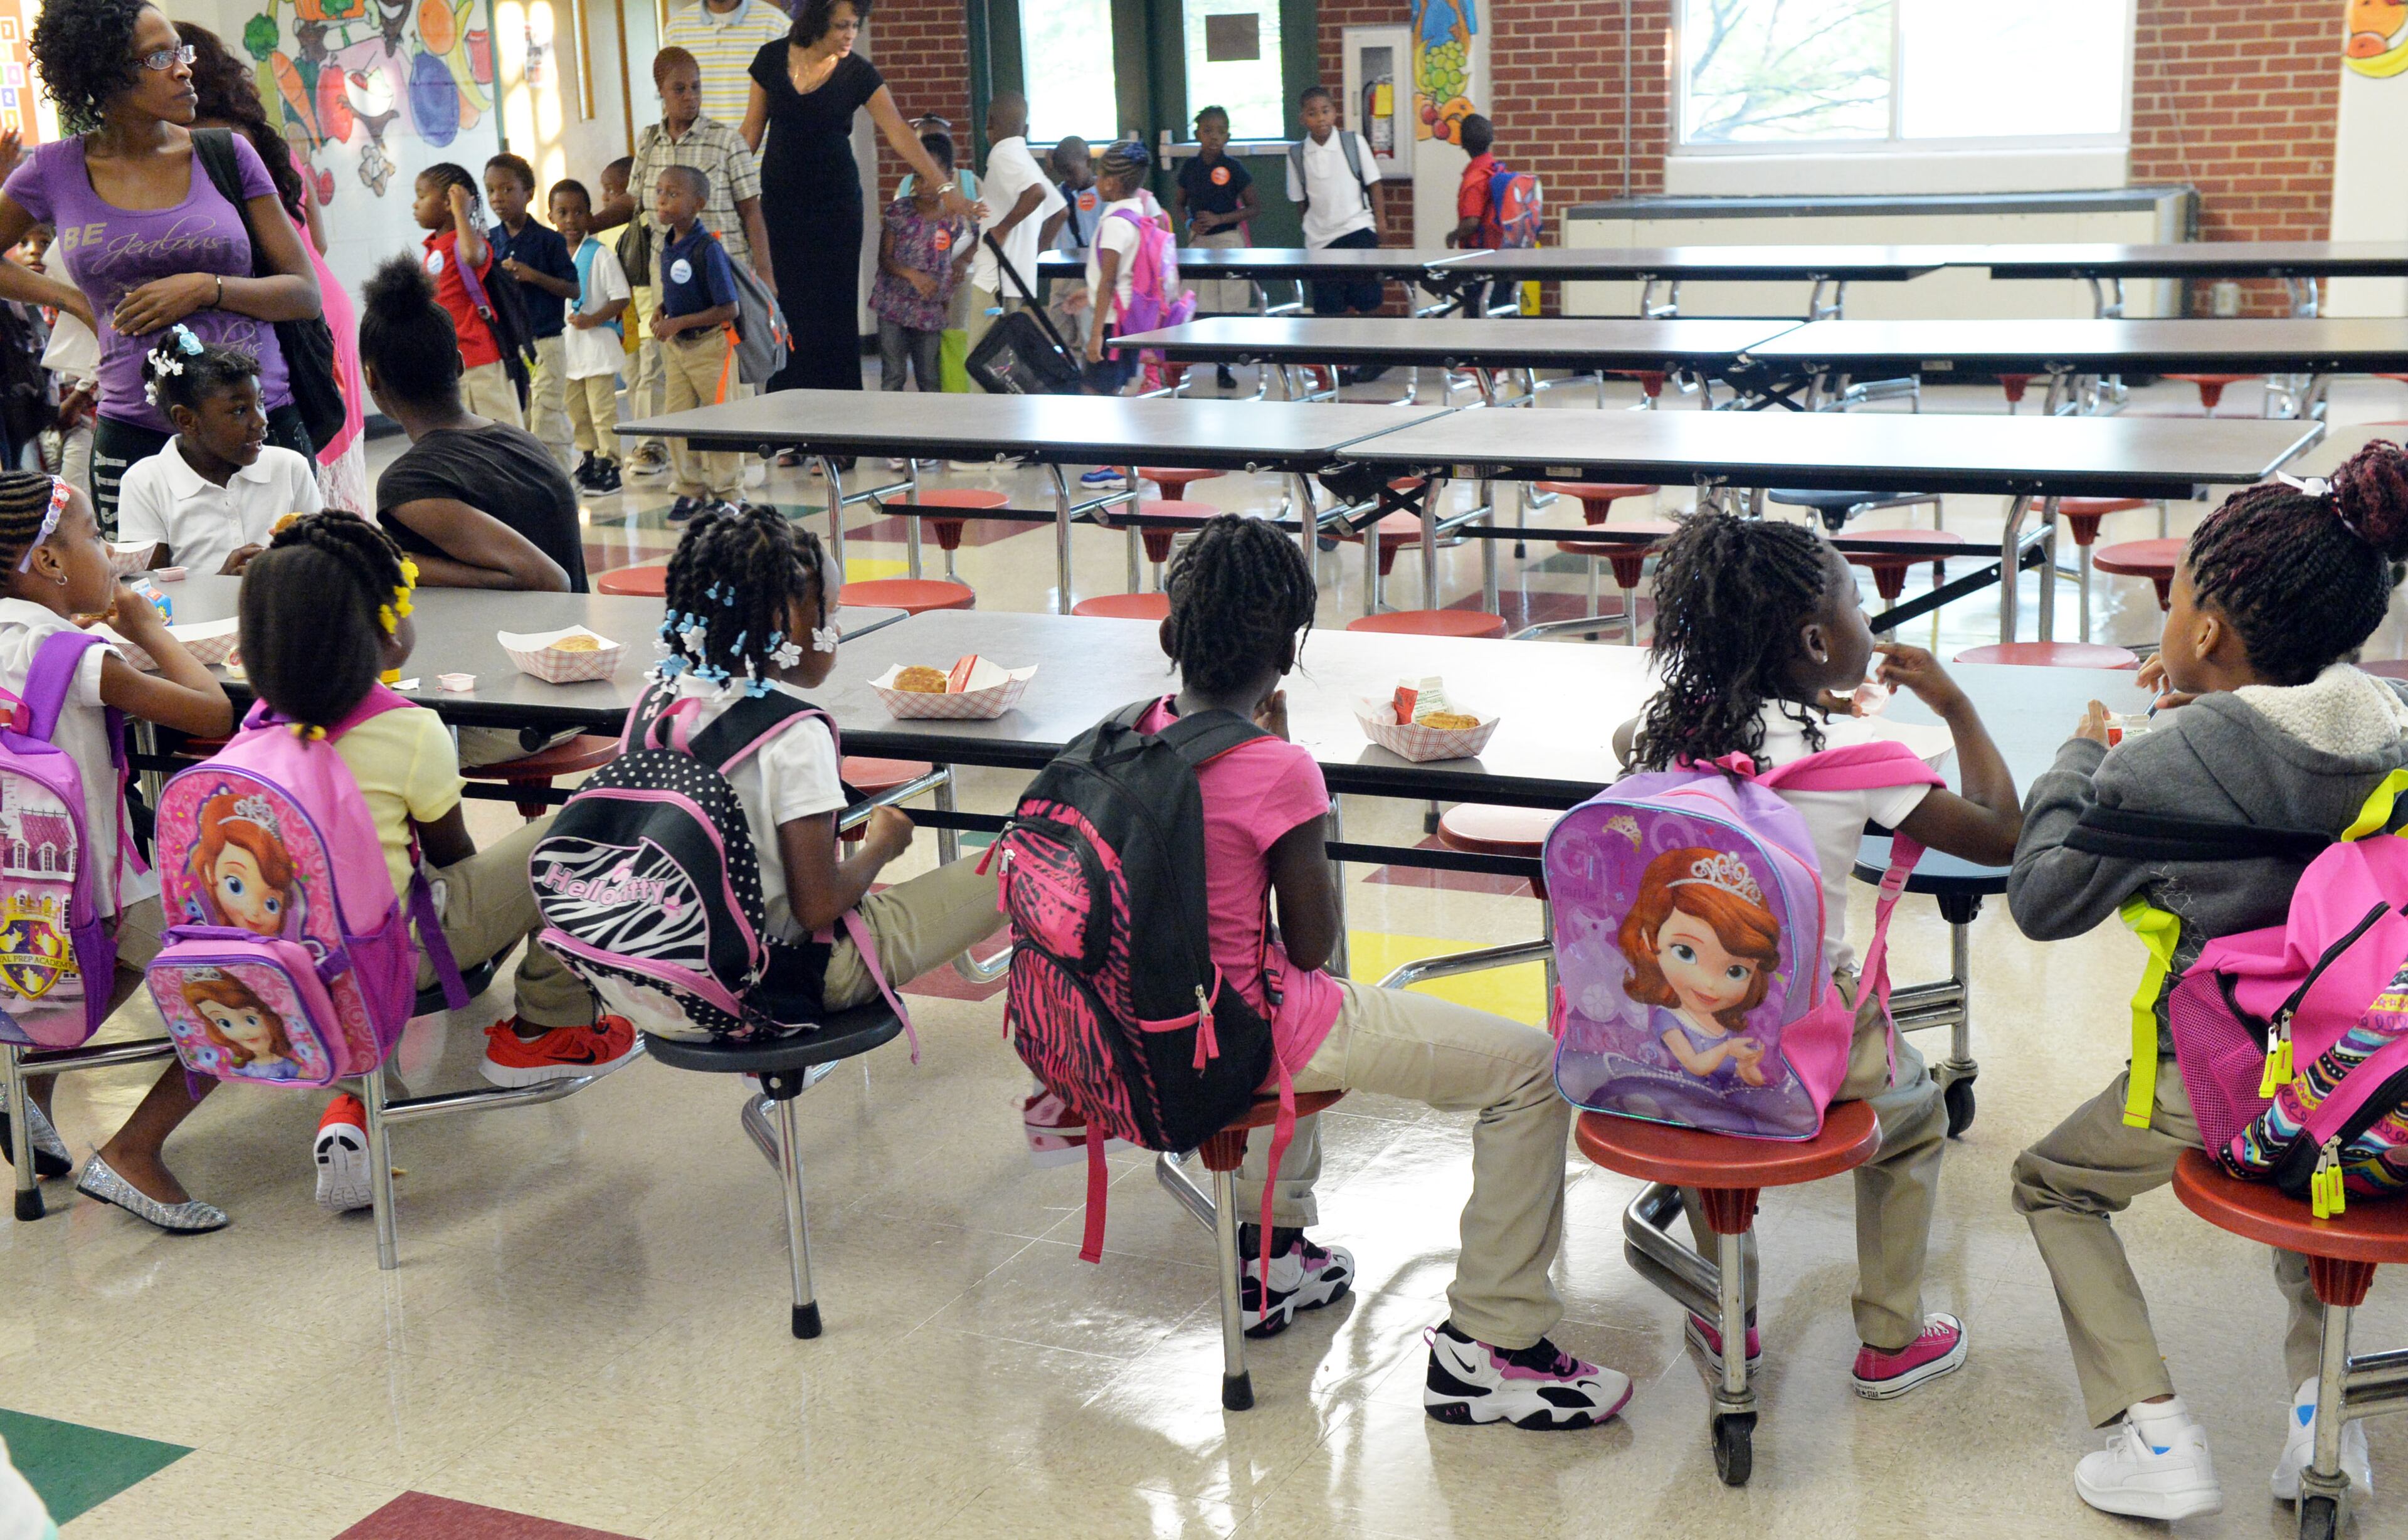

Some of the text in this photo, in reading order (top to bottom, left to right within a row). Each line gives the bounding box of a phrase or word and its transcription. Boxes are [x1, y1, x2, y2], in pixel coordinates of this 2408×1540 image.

[63, 222, 108, 251] BE
[543, 862, 618, 906] Hello
[14, 955, 33, 963] PREP
[1445, 1406, 1466, 1416] AIR
